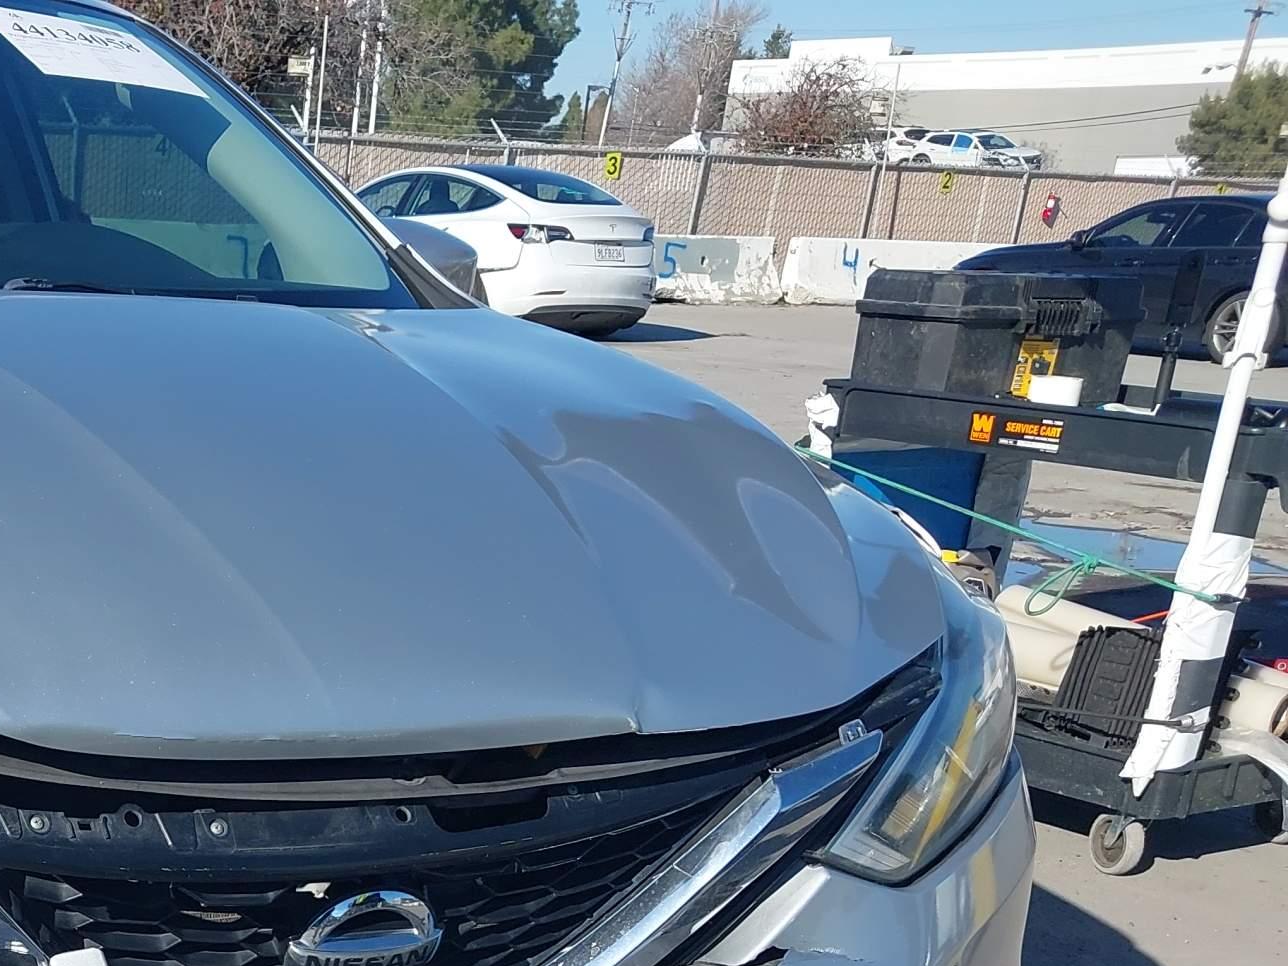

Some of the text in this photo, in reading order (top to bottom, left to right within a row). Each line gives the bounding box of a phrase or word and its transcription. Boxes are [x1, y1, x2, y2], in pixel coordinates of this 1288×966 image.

[11, 22, 141, 53] 44134058
[606, 156, 619, 176] 3
[942, 171, 953, 190] 2
[658, 241, 688, 279] 5
[842, 241, 859, 287] 4
[1005, 421, 1040, 436] SERVICE
[1039, 425, 1064, 438] CART
